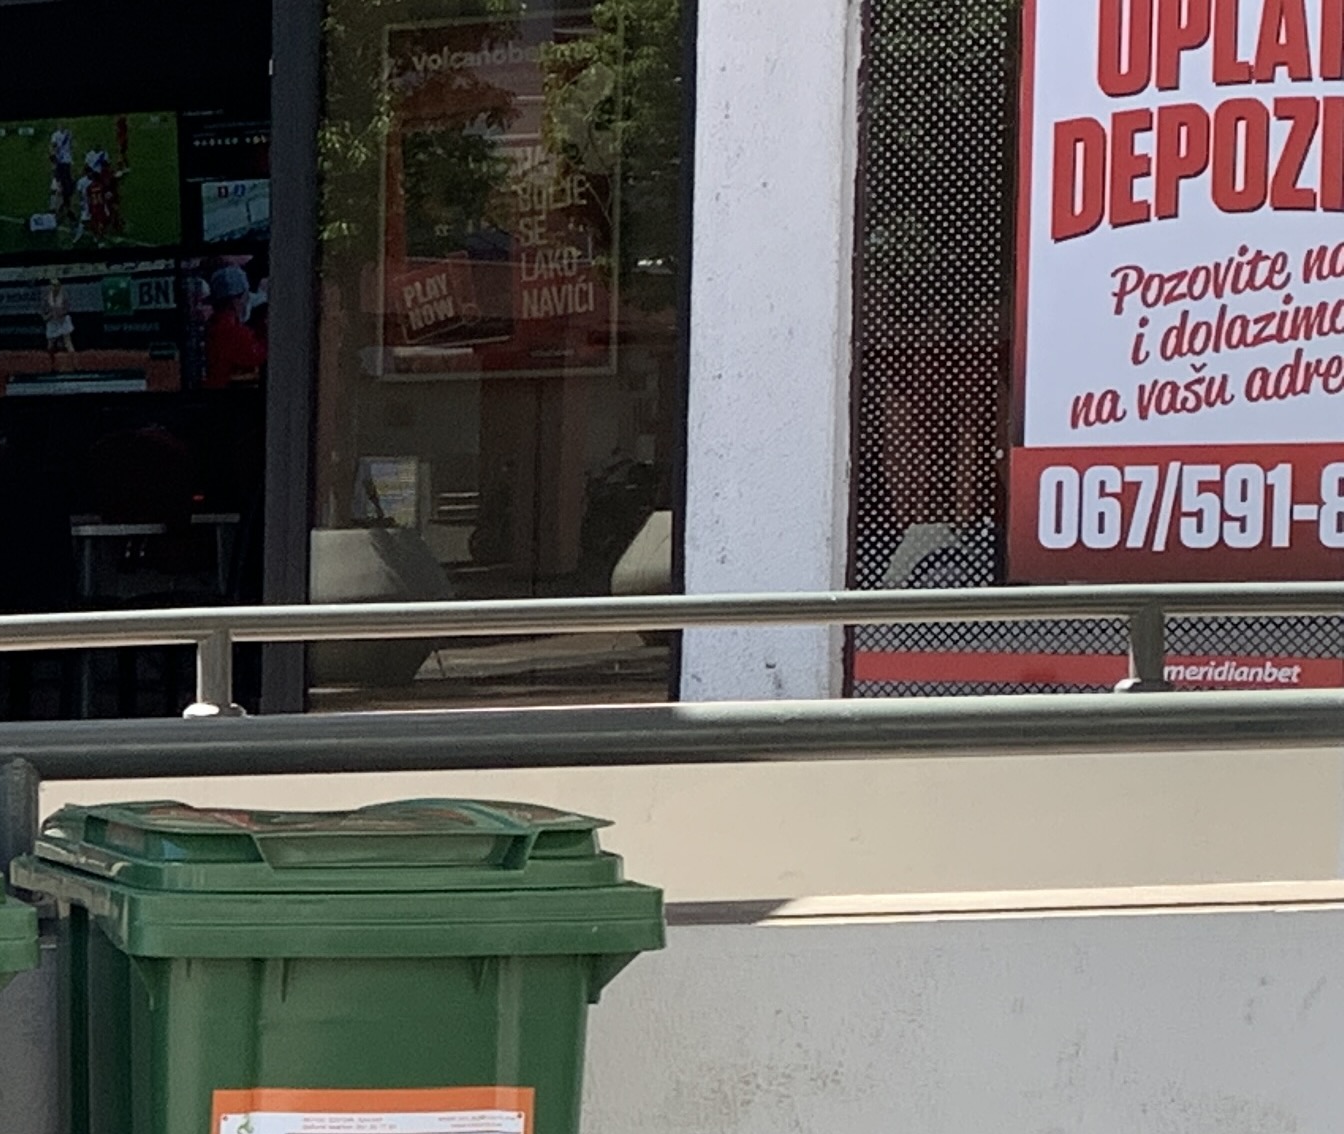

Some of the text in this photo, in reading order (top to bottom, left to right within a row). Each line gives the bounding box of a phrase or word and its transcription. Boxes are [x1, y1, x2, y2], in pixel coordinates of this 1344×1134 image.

[403, 273, 447, 306] PLAY
[522, 277, 595, 320] NAVIĆI
[1111, 244, 1291, 316] Pozovite
[409, 298, 455, 332] NOW
[1132, 315, 1150, 366] i
[1071, 389, 1127, 430] na
[1137, 363, 1235, 421] vašu
[1038, 461, 1343, 552] 067/591-8
[1163, 661, 1302, 683] meridianbet
